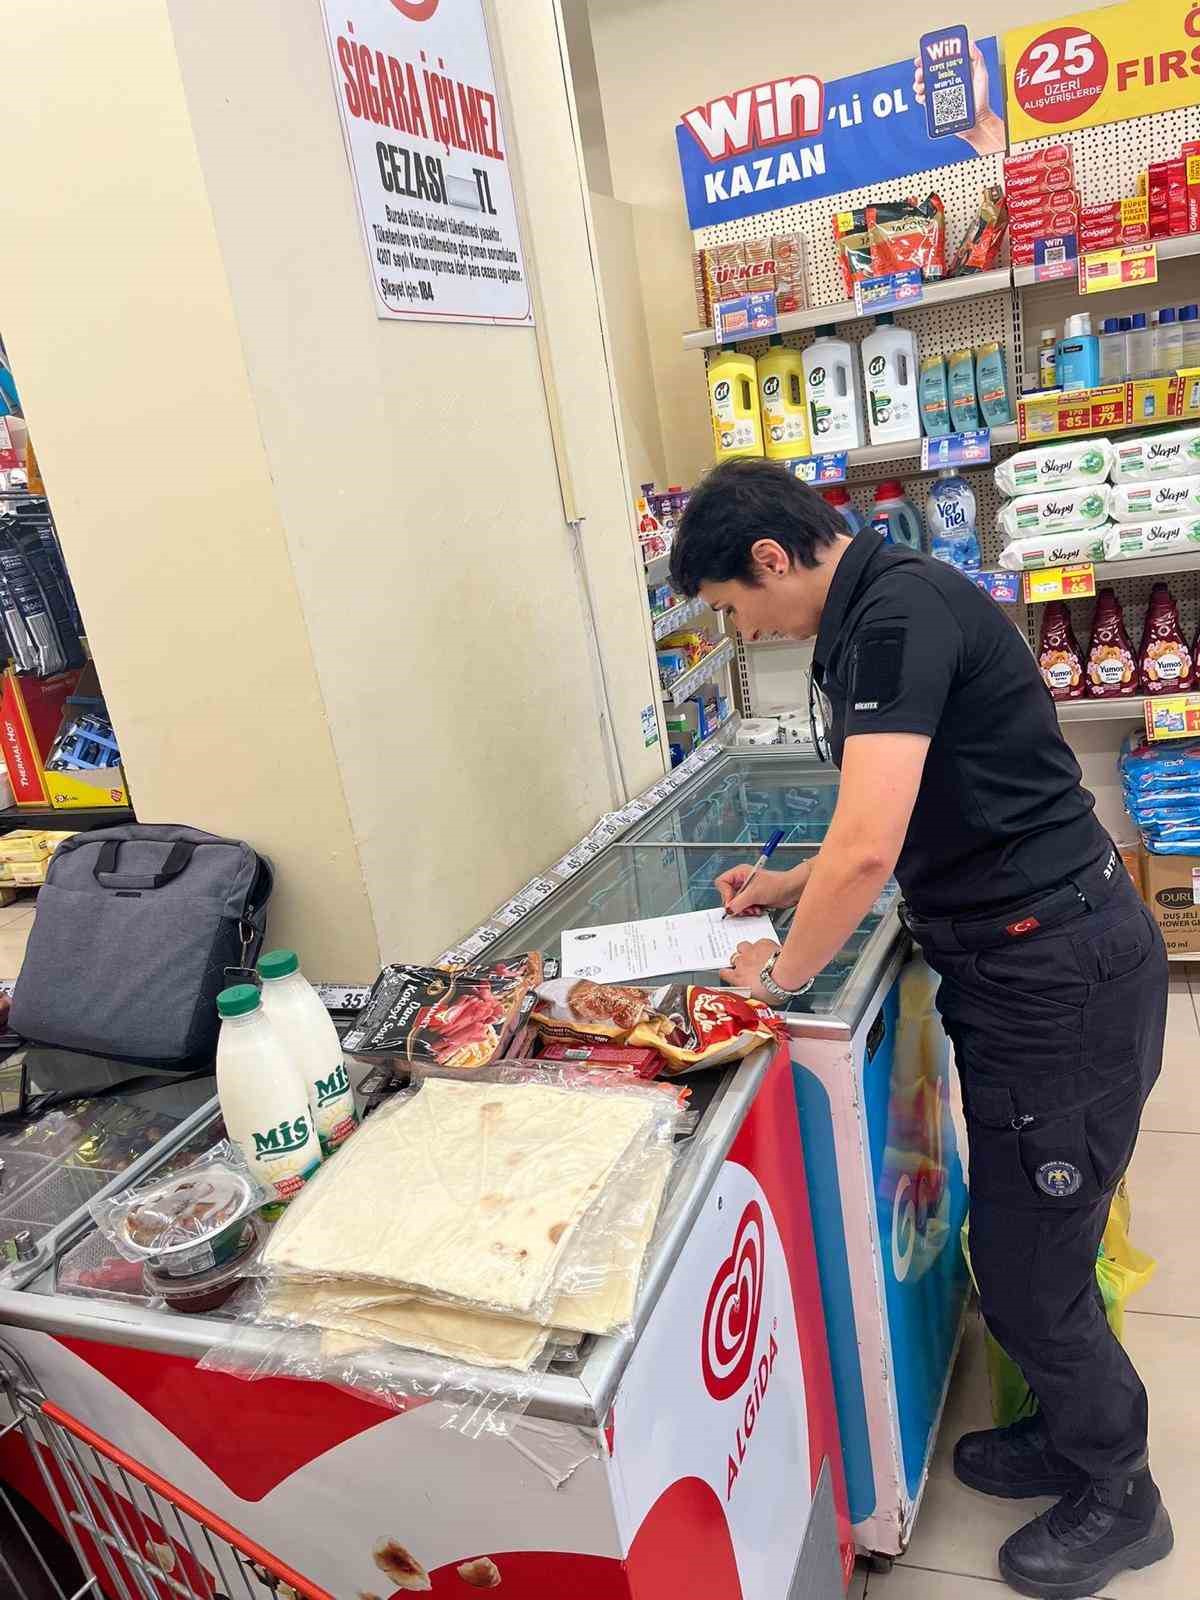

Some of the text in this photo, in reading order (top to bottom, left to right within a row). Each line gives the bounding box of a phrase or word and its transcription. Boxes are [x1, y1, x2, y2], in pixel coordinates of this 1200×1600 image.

[337, 20, 504, 161] SİGARA İÇİLMEZ
[1044, 78, 1081, 96] ÜZERİ
[872, 89, 909, 119] OL
[1023, 86, 1103, 110] ALIŞVERİŞLERDE
[376, 141, 497, 215] CEZASI TL
[704, 144, 826, 203] KAZAN
[1007, 175, 1038, 187] Colgate
[1010, 197, 1041, 209] Colgate
[1081, 205, 1113, 216] Colgate
[1013, 219, 1044, 230] Colgate
[1082, 227, 1113, 238] Colgate
[376, 248, 391, 266] 4207
[409, 253, 430, 270] Kanun
[715, 260, 777, 285] ÜLKER
[418, 280, 434, 300] 184
[869, 357, 885, 374] Cif
[810, 368, 825, 385] Cif
[715, 383, 729, 399] Cif
[764, 378, 779, 394] Cif
[1147, 444, 1180, 460] Sleepy
[1041, 458, 1073, 474] Sleepy
[1155, 488, 1189, 503] Sleepy
[1042, 503, 1074, 517] Sleepy
[1147, 526, 1180, 541] Sleepy
[1048, 549, 1080, 562] Sleepy
[1100, 665, 1124, 674] Yumos
[1157, 661, 1182, 670] Yumos
[1050, 670, 1072, 678] Yumos
[5, 721, 29, 787] THERMAL HOT
[509, 904, 527, 918] 50
[1160, 920, 1190, 928] HOWER
[479, 930, 497, 943] 45
[391, 983, 419, 1025] Kokteyl
[397, 1001, 421, 1027] Dana
